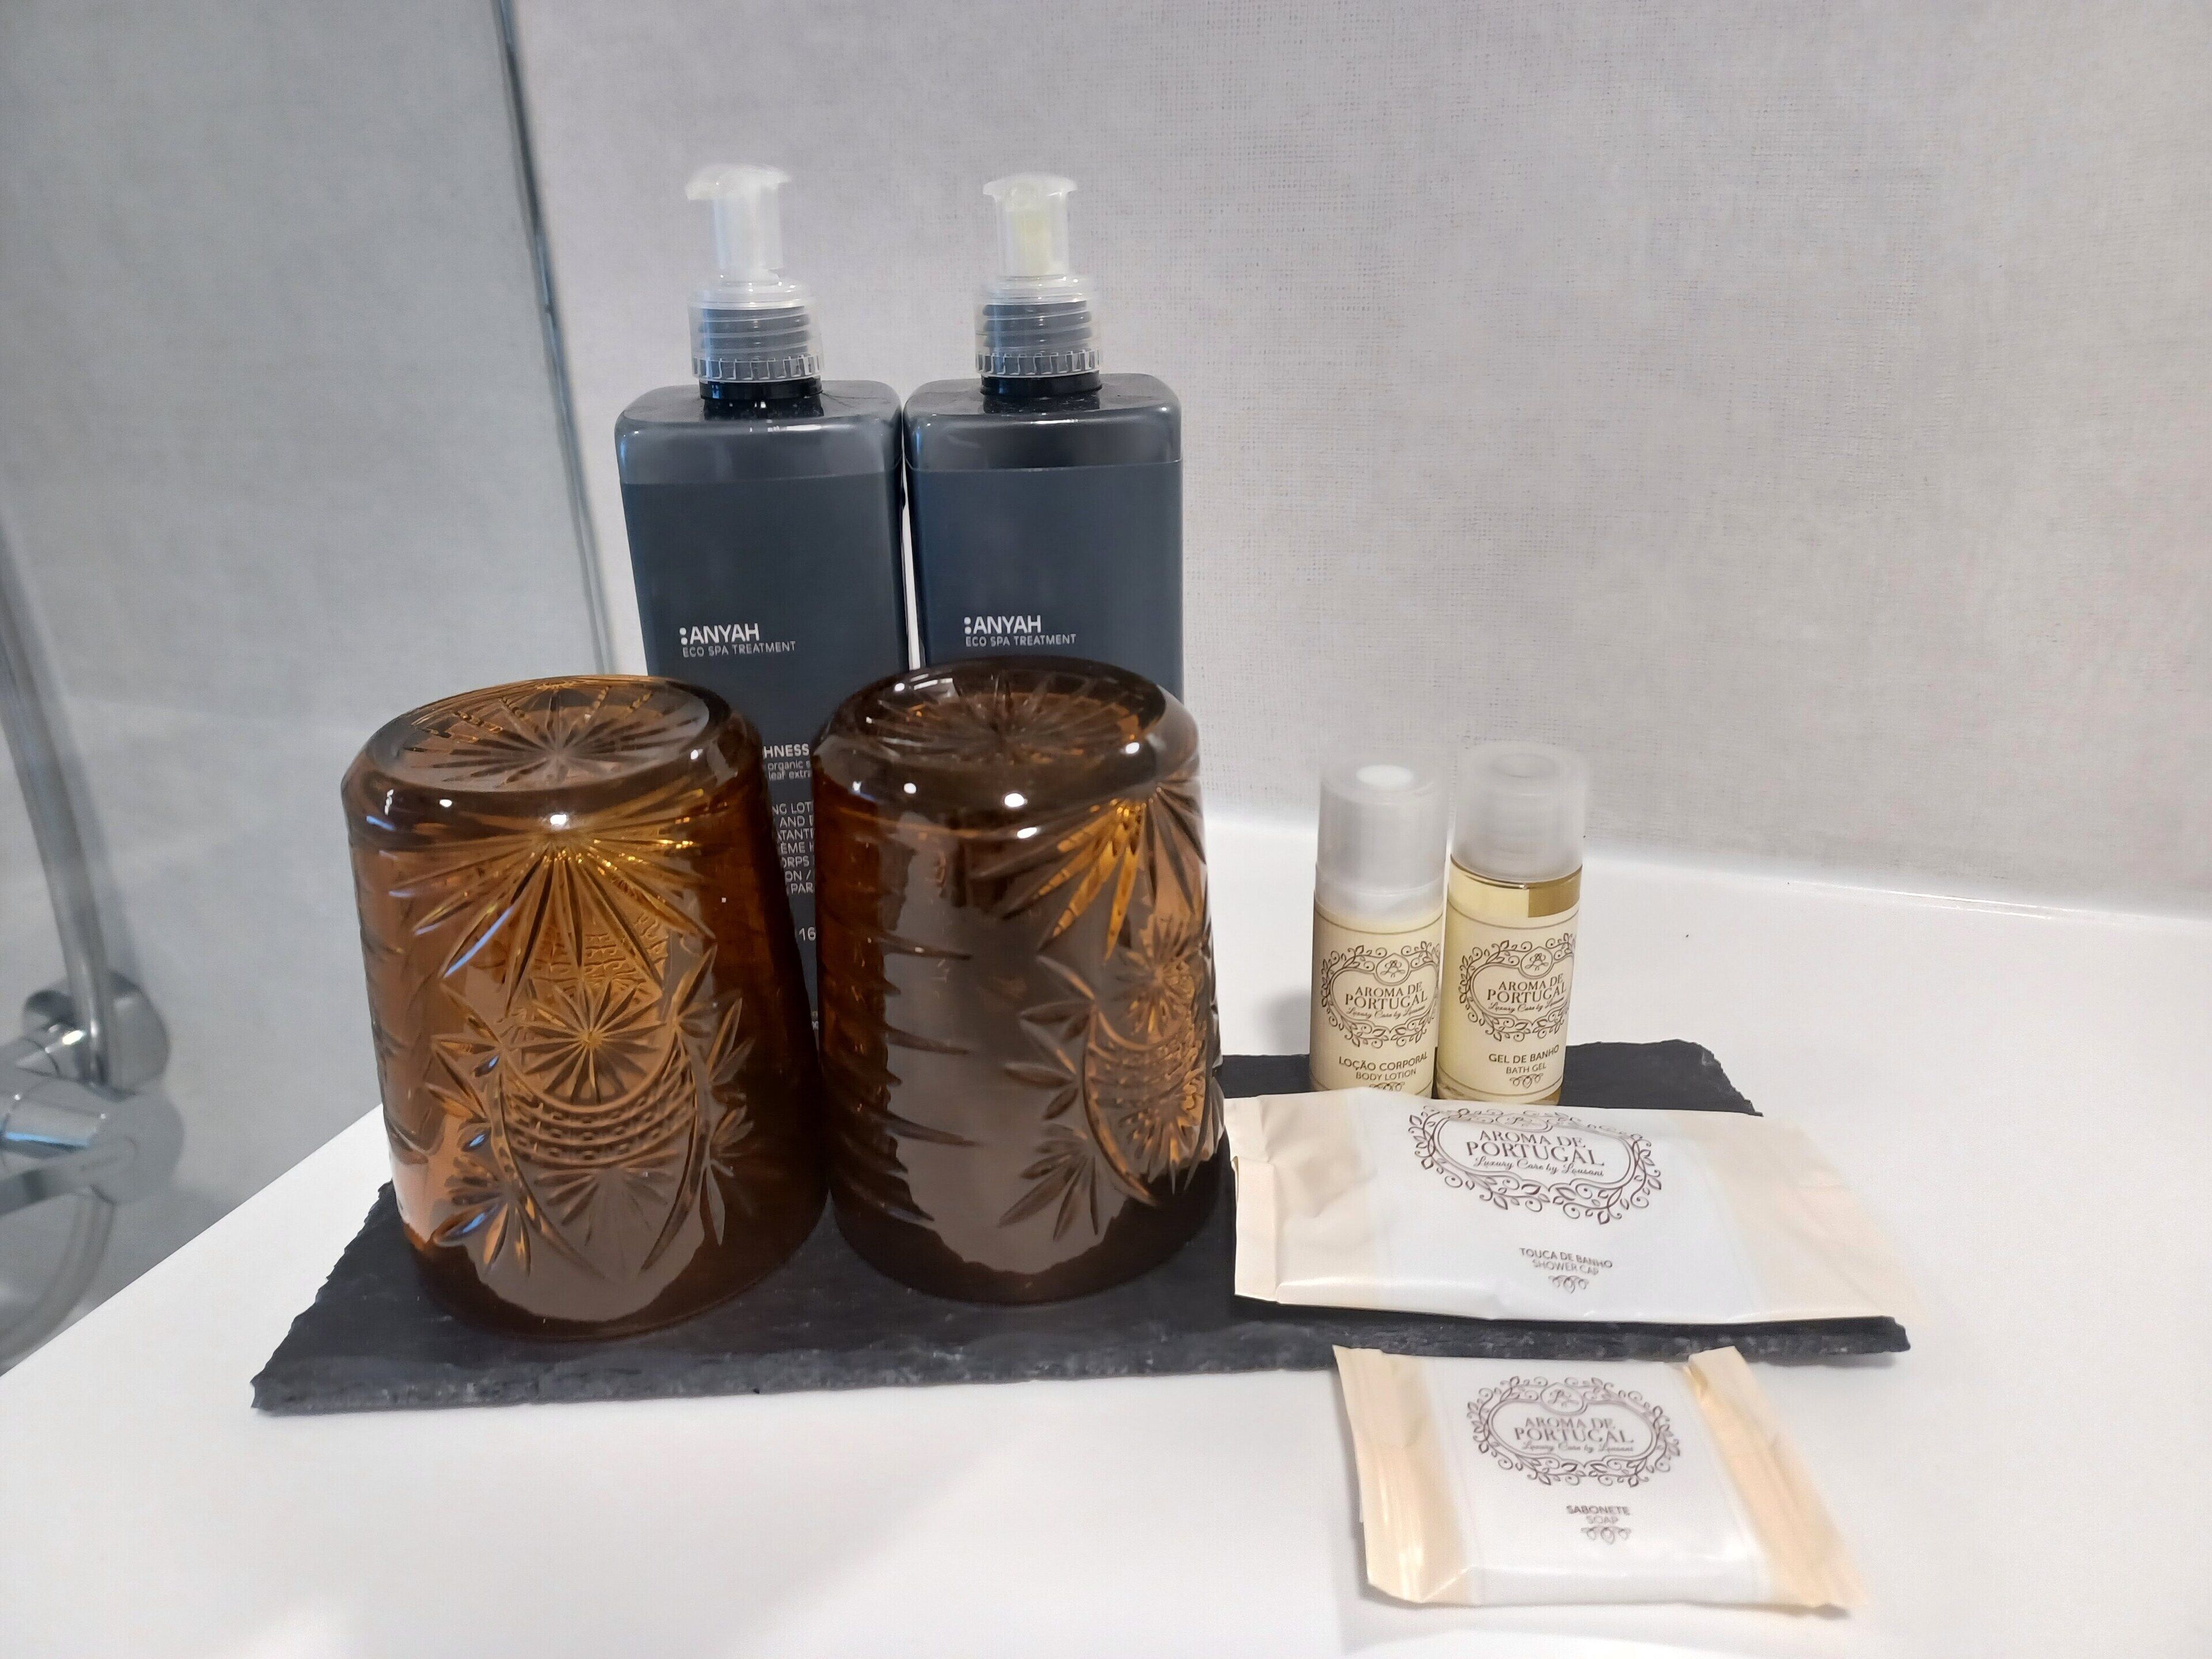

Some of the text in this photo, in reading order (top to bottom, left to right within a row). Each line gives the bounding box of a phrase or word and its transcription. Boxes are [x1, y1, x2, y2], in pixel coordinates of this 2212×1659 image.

[965, 634, 1077, 647] ECO SPA TREATMENT
[683, 641, 796, 658] ECO SPA TREATMENT
[767, 759, 804, 772] organic
[779, 815, 805, 828] AND
[1355, 982, 1422, 997] AROMA DE
[1499, 973, 1563, 991] AROMA DE
[1345, 990, 1427, 1010] PORTUGAL
[1487, 982, 1566, 1003] PORTUGAL
[1339, 1051, 1427, 1071] LOÇÃO CORPORAL
[1488, 1044, 1559, 1064] GEL DE BANHO
[1355, 1068, 1416, 1081] BODY LOTION
[1506, 1062, 1547, 1074] BATH GEL
[1480, 1130, 1586, 1148] AROMA DE
[1466, 1141, 1604, 1166] PORTUGAL
[1474, 1156, 1513, 1170] Luxury
[1517, 1158, 1544, 1171] Care
[1545, 1163, 1558, 1175] by
[1519, 1248, 1613, 1268] TOUCA DE BANHO
[1532, 1259, 1577, 1271] SHOWER
[1526, 1417, 1615, 1429] AROMA DE
[1514, 1427, 1634, 1443] PORTUGAL
[1566, 1505, 1630, 1516] SABONETE
